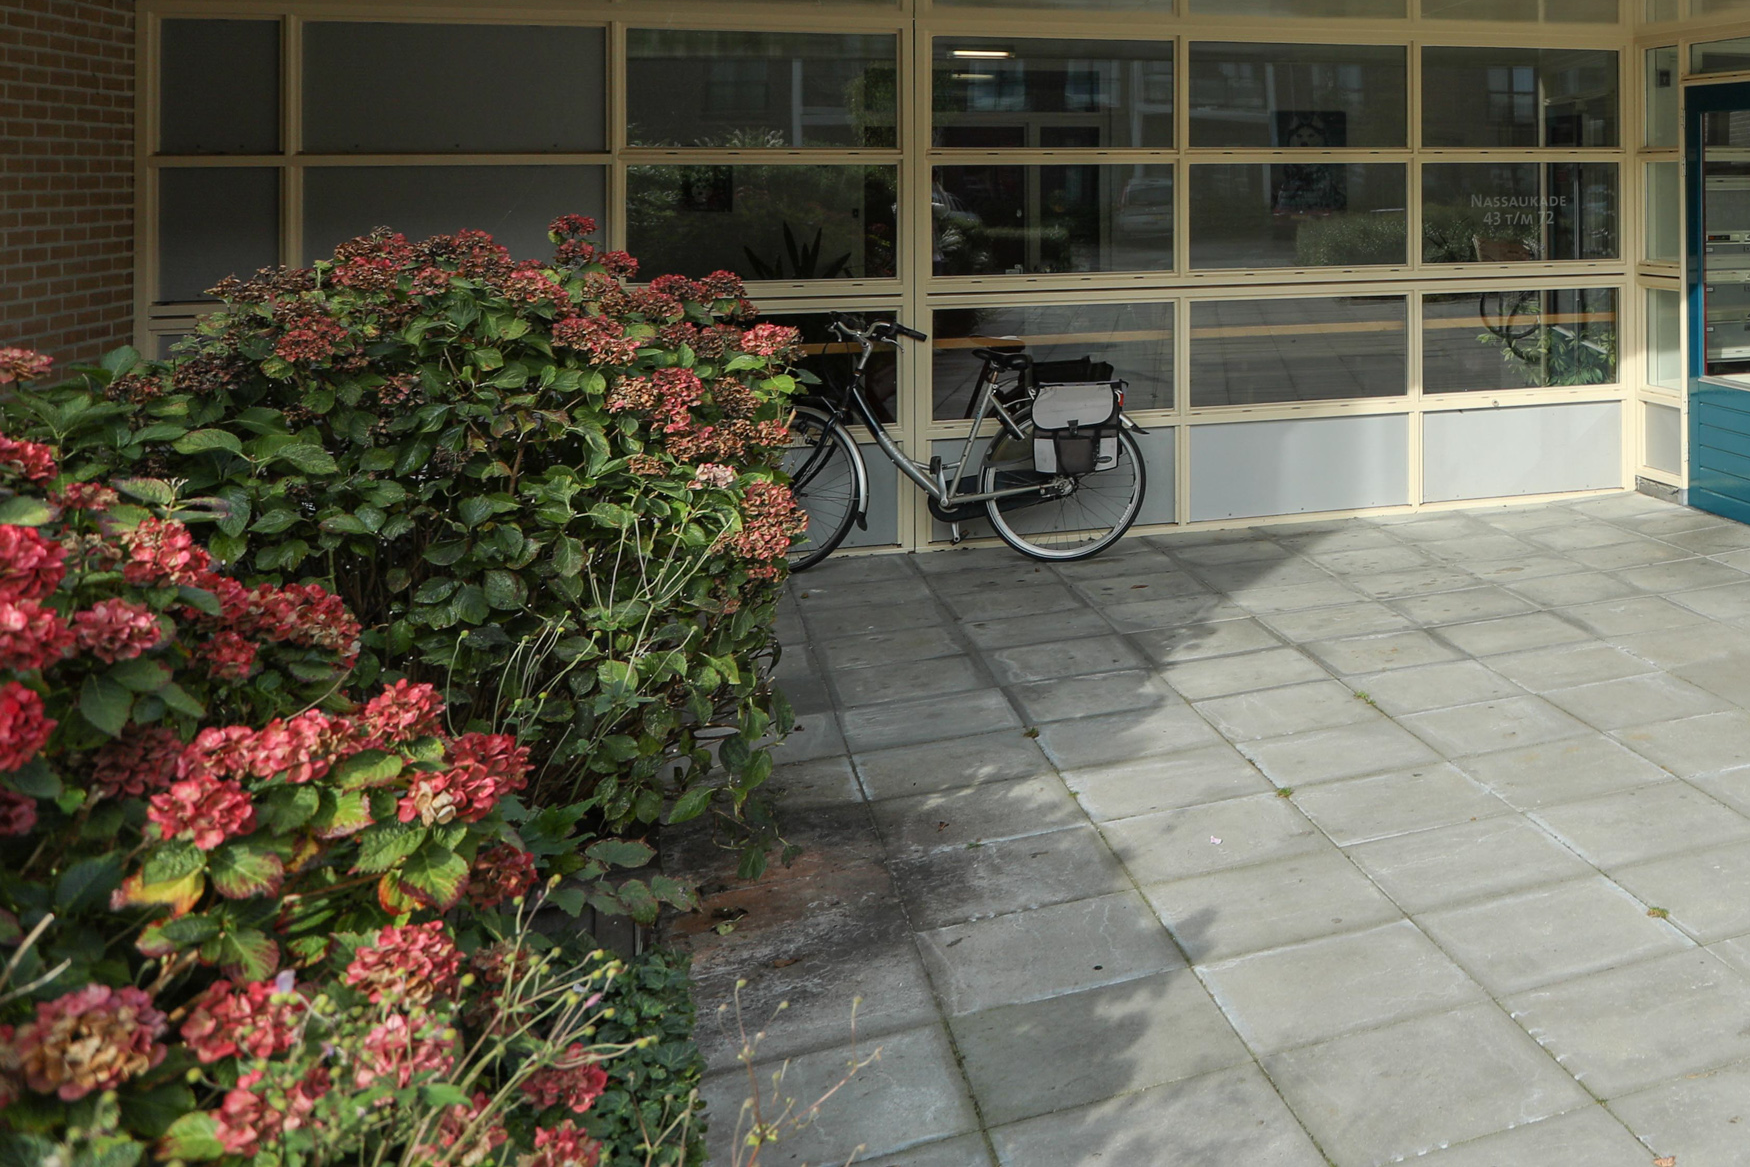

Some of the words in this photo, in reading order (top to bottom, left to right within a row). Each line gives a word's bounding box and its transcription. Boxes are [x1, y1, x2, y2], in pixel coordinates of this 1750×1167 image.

[1471, 194, 1567, 208] NASSAUKADE
[1483, 211, 1501, 225] 43
[1538, 210, 1555, 225] 72
